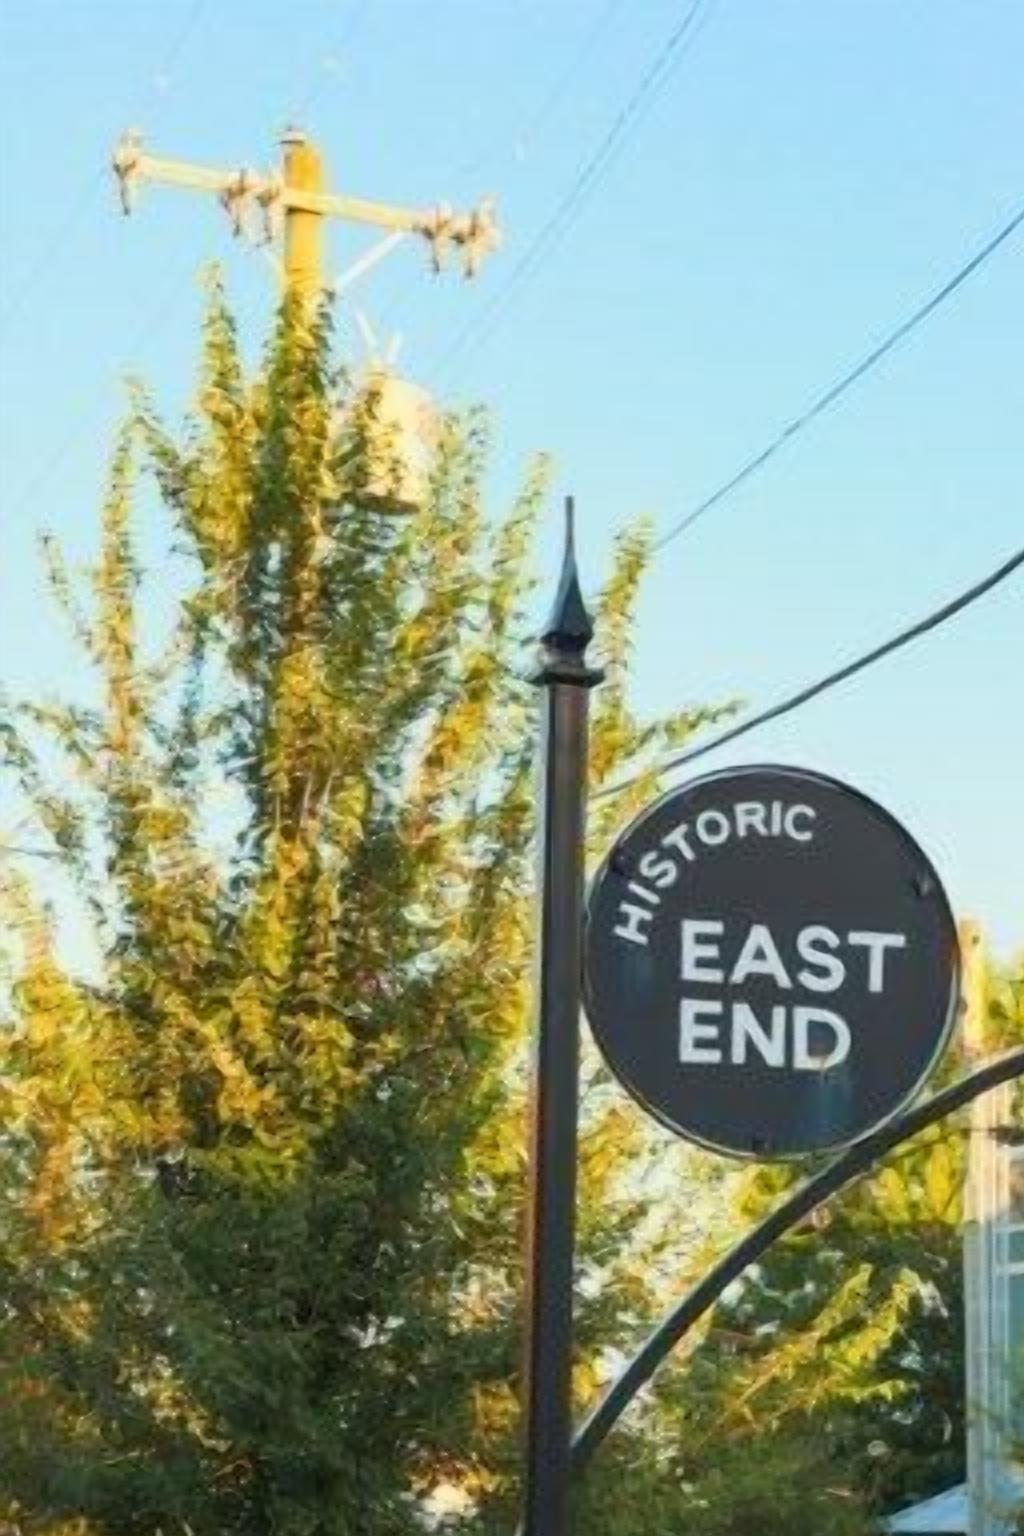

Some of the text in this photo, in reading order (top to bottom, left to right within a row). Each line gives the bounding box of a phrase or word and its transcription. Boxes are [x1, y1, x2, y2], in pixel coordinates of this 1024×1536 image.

[613, 800, 817, 946] HISTORIC
[679, 918, 907, 994] EAST
[678, 997, 852, 1071] END
